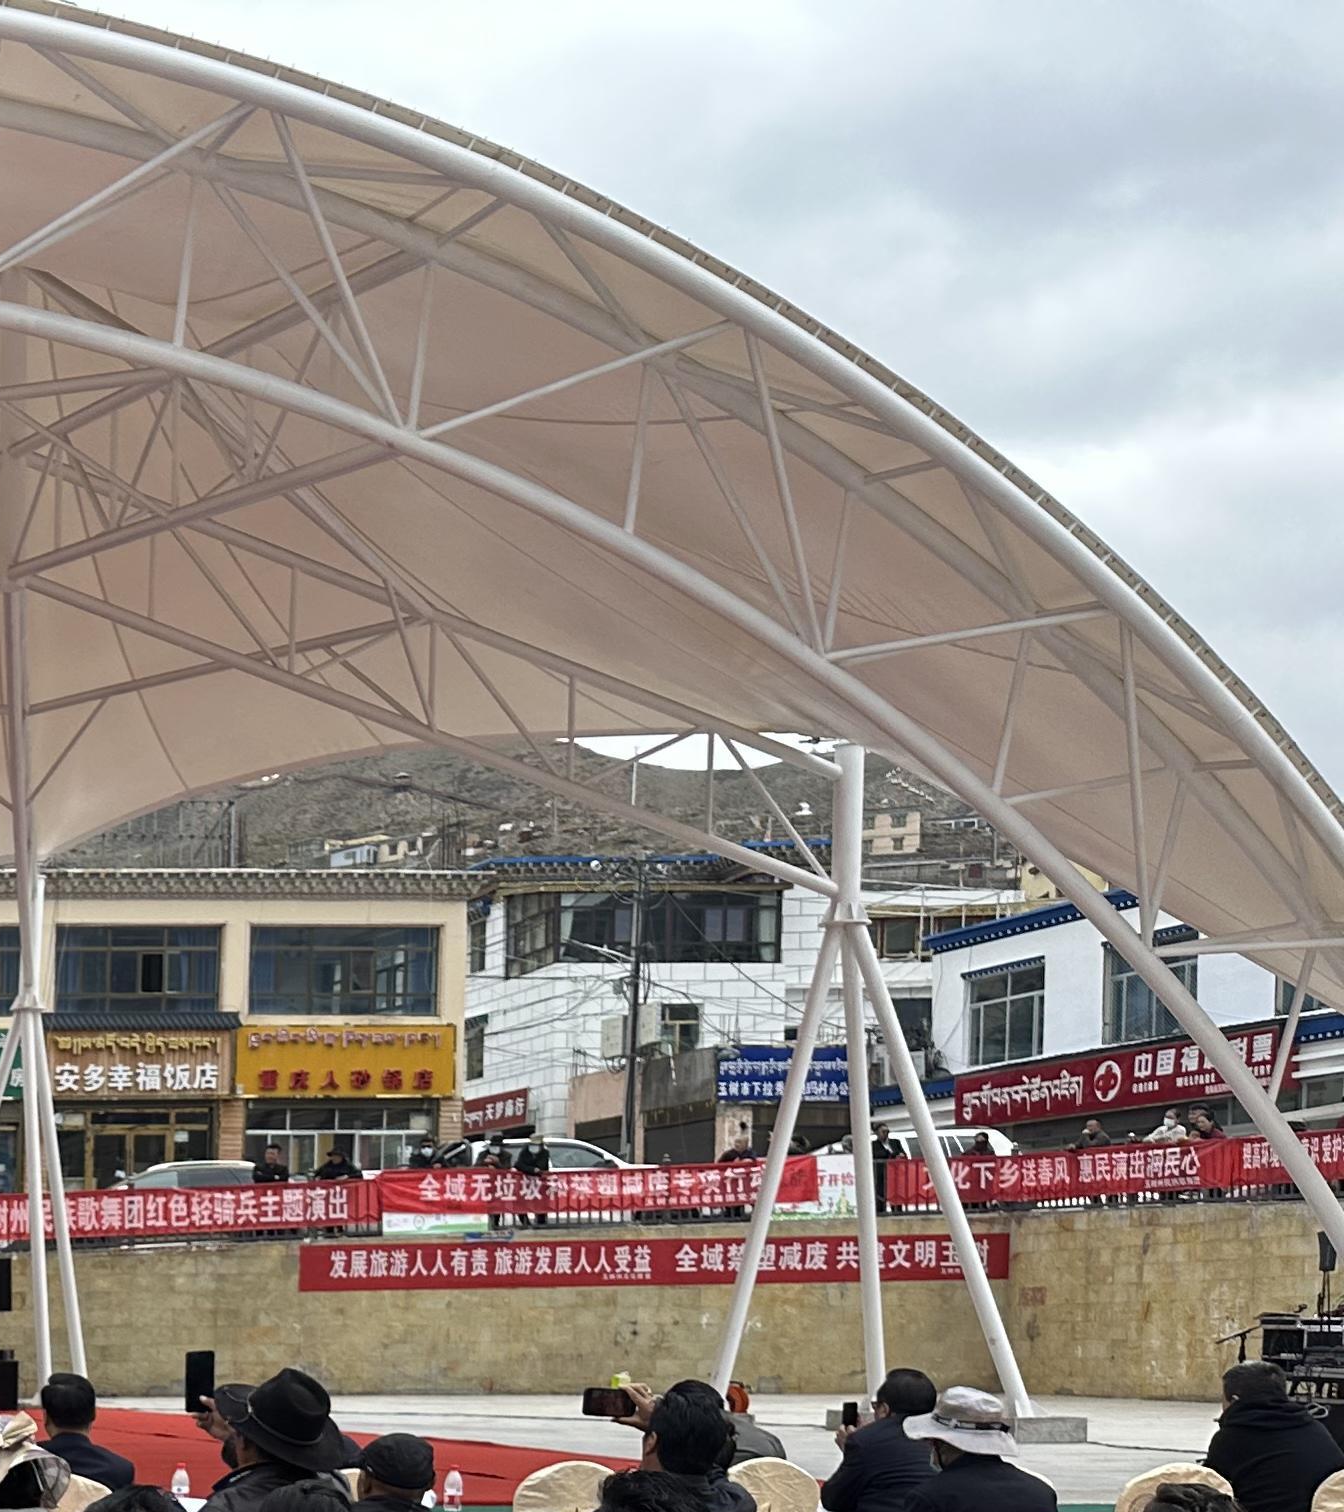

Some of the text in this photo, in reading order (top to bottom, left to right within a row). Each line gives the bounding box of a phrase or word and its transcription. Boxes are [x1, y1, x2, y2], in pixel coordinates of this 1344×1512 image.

[1133, 1032, 1273, 1078] 中国福彩票
[54, 1062, 219, 1092] 安多幸福饭店
[258, 1069, 433, 1090] 重庆人砂锅店
[330, 1249, 489, 1278] 发展旅游人人有责
[494, 1245, 652, 1274] 旅游发展人人受益
[675, 1242, 828, 1273] 全域禁塑减废
